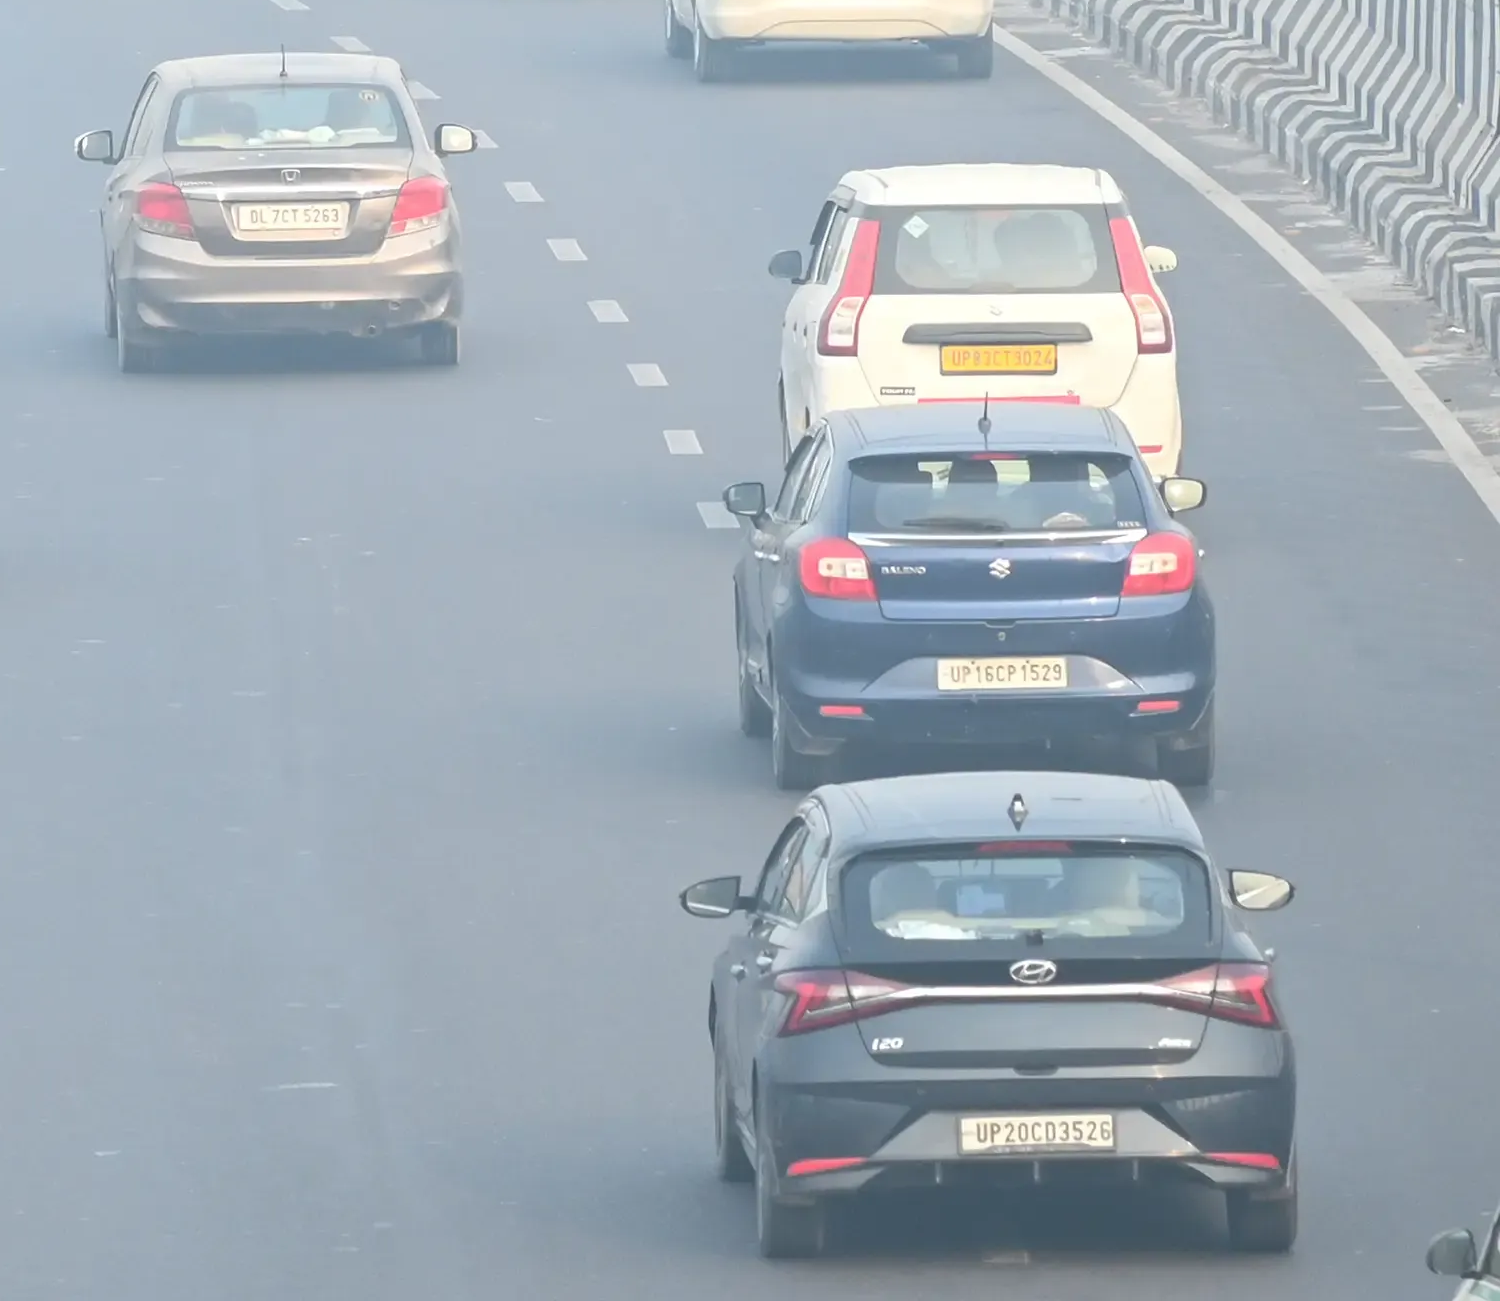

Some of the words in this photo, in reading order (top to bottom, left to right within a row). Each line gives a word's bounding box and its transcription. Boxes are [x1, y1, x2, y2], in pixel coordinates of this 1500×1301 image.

[250, 209, 268, 224] DL
[272, 208, 298, 224] 7CT
[303, 208, 340, 223] 5263
[950, 663, 1062, 683] UP16CP1529
[975, 1120, 1112, 1144] UP20CD3526
